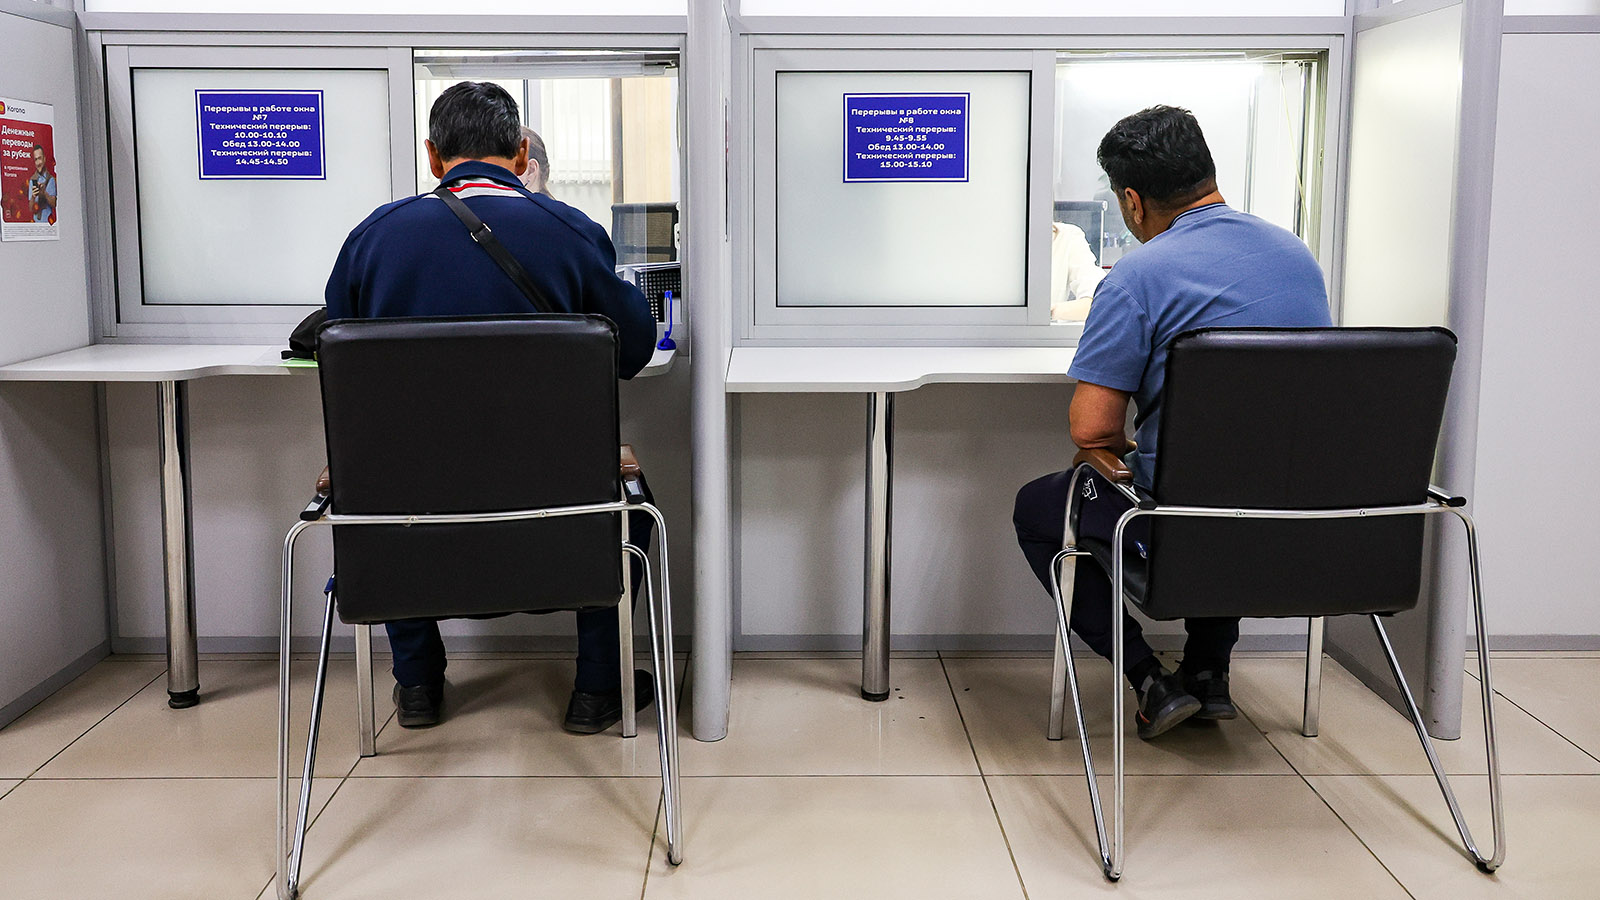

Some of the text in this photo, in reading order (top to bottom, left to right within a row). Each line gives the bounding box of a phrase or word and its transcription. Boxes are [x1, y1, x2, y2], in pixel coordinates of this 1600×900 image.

[7, 105, 26, 114] Korona
[204, 105, 251, 113] Перерывы
[259, 105, 291, 114] работе
[851, 108, 897, 117] Перерывы
[906, 108, 938, 117] работе
[1, 125, 35, 137] Денежные
[2, 139, 34, 148] переводы
[868, 143, 891, 151] Обед
[11, 150, 31, 159] рубеж
